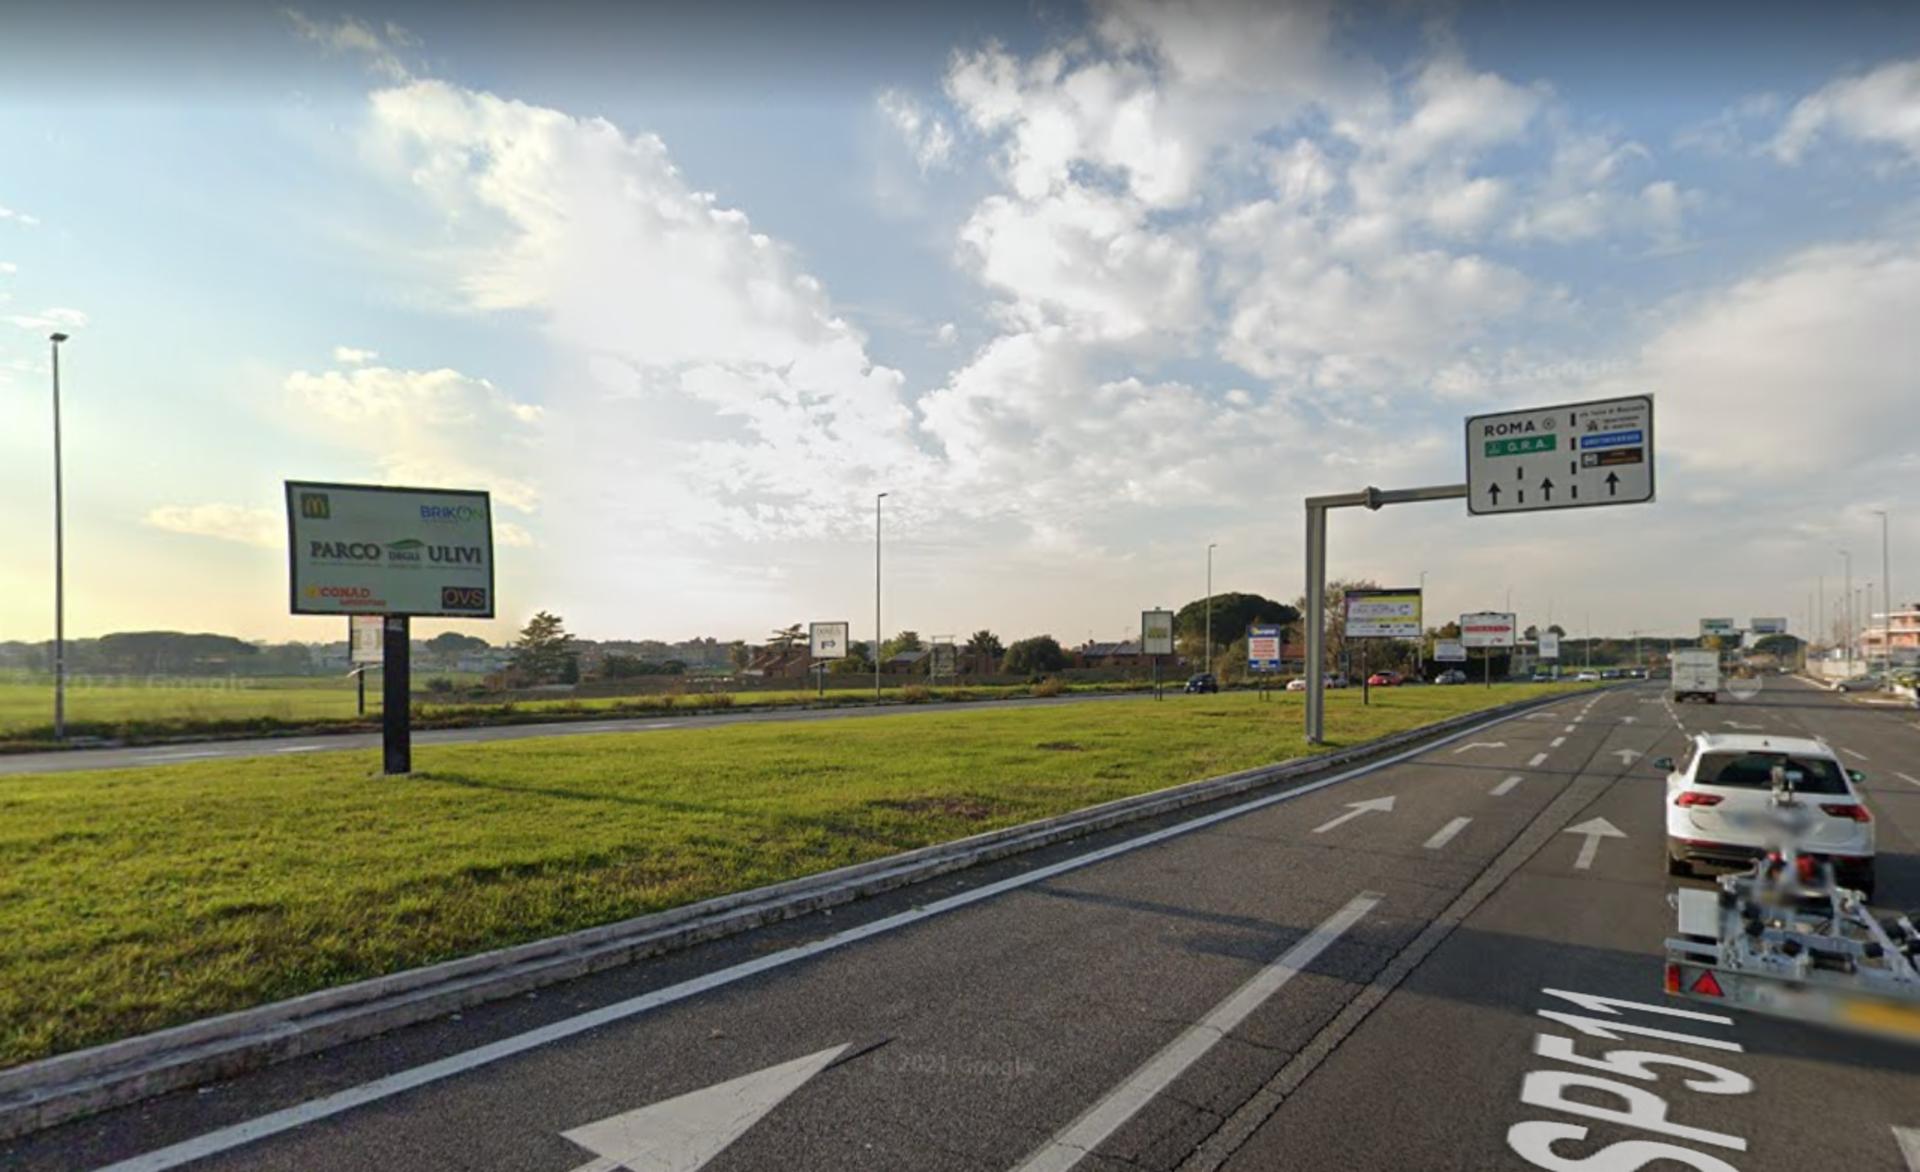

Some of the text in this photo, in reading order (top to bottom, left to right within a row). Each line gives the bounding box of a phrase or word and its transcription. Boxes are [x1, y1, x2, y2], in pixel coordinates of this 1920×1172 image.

[1484, 419, 1535, 437] ROMA
[310, 541, 380, 560] PARCO
[428, 546, 482, 564] ULIVI
[320, 587, 370, 598] CONAD
[443, 589, 486, 606] OVS
[1506, 988, 1756, 1172] SP511
